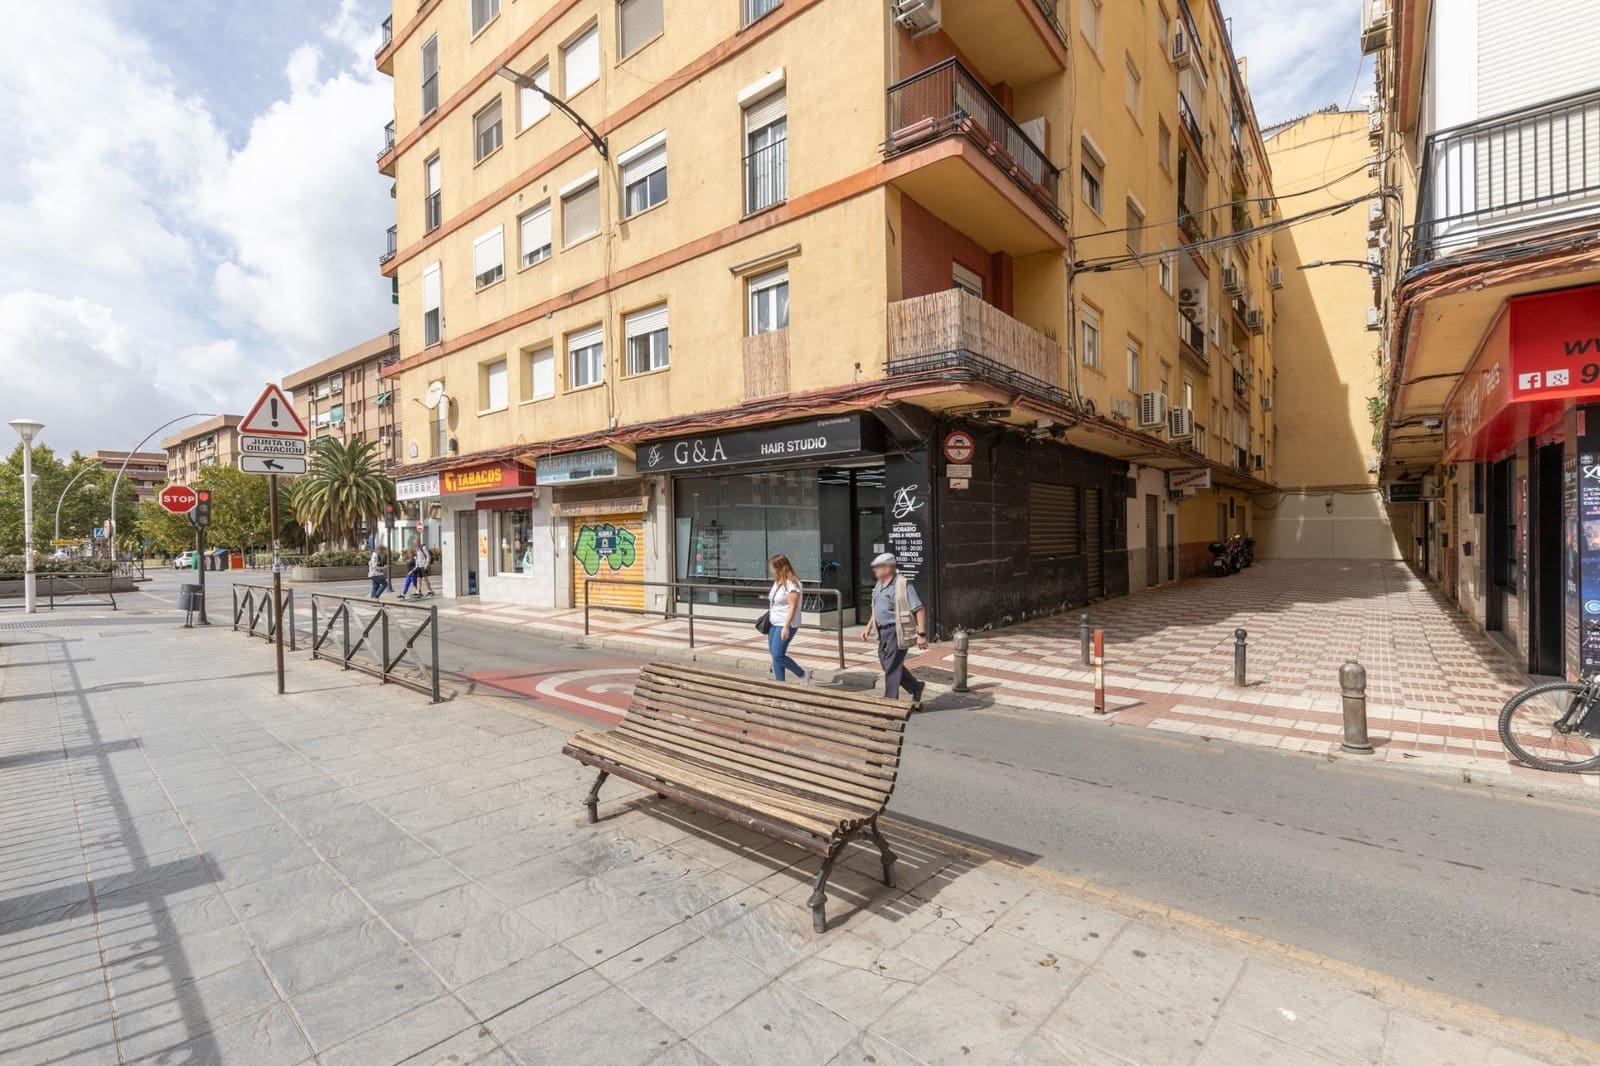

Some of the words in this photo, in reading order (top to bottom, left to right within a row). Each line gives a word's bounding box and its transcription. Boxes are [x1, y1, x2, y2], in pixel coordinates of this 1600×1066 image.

[1563, 337, 1600, 356] w
[251, 438, 284, 447] JUNTA
[285, 440, 298, 448] DE
[673, 436, 728, 464] G&A
[760, 442, 785, 455] HAIR
[787, 436, 827, 452] STUDIO
[458, 467, 502, 486] TABACOS
[163, 495, 195, 503] STOP
